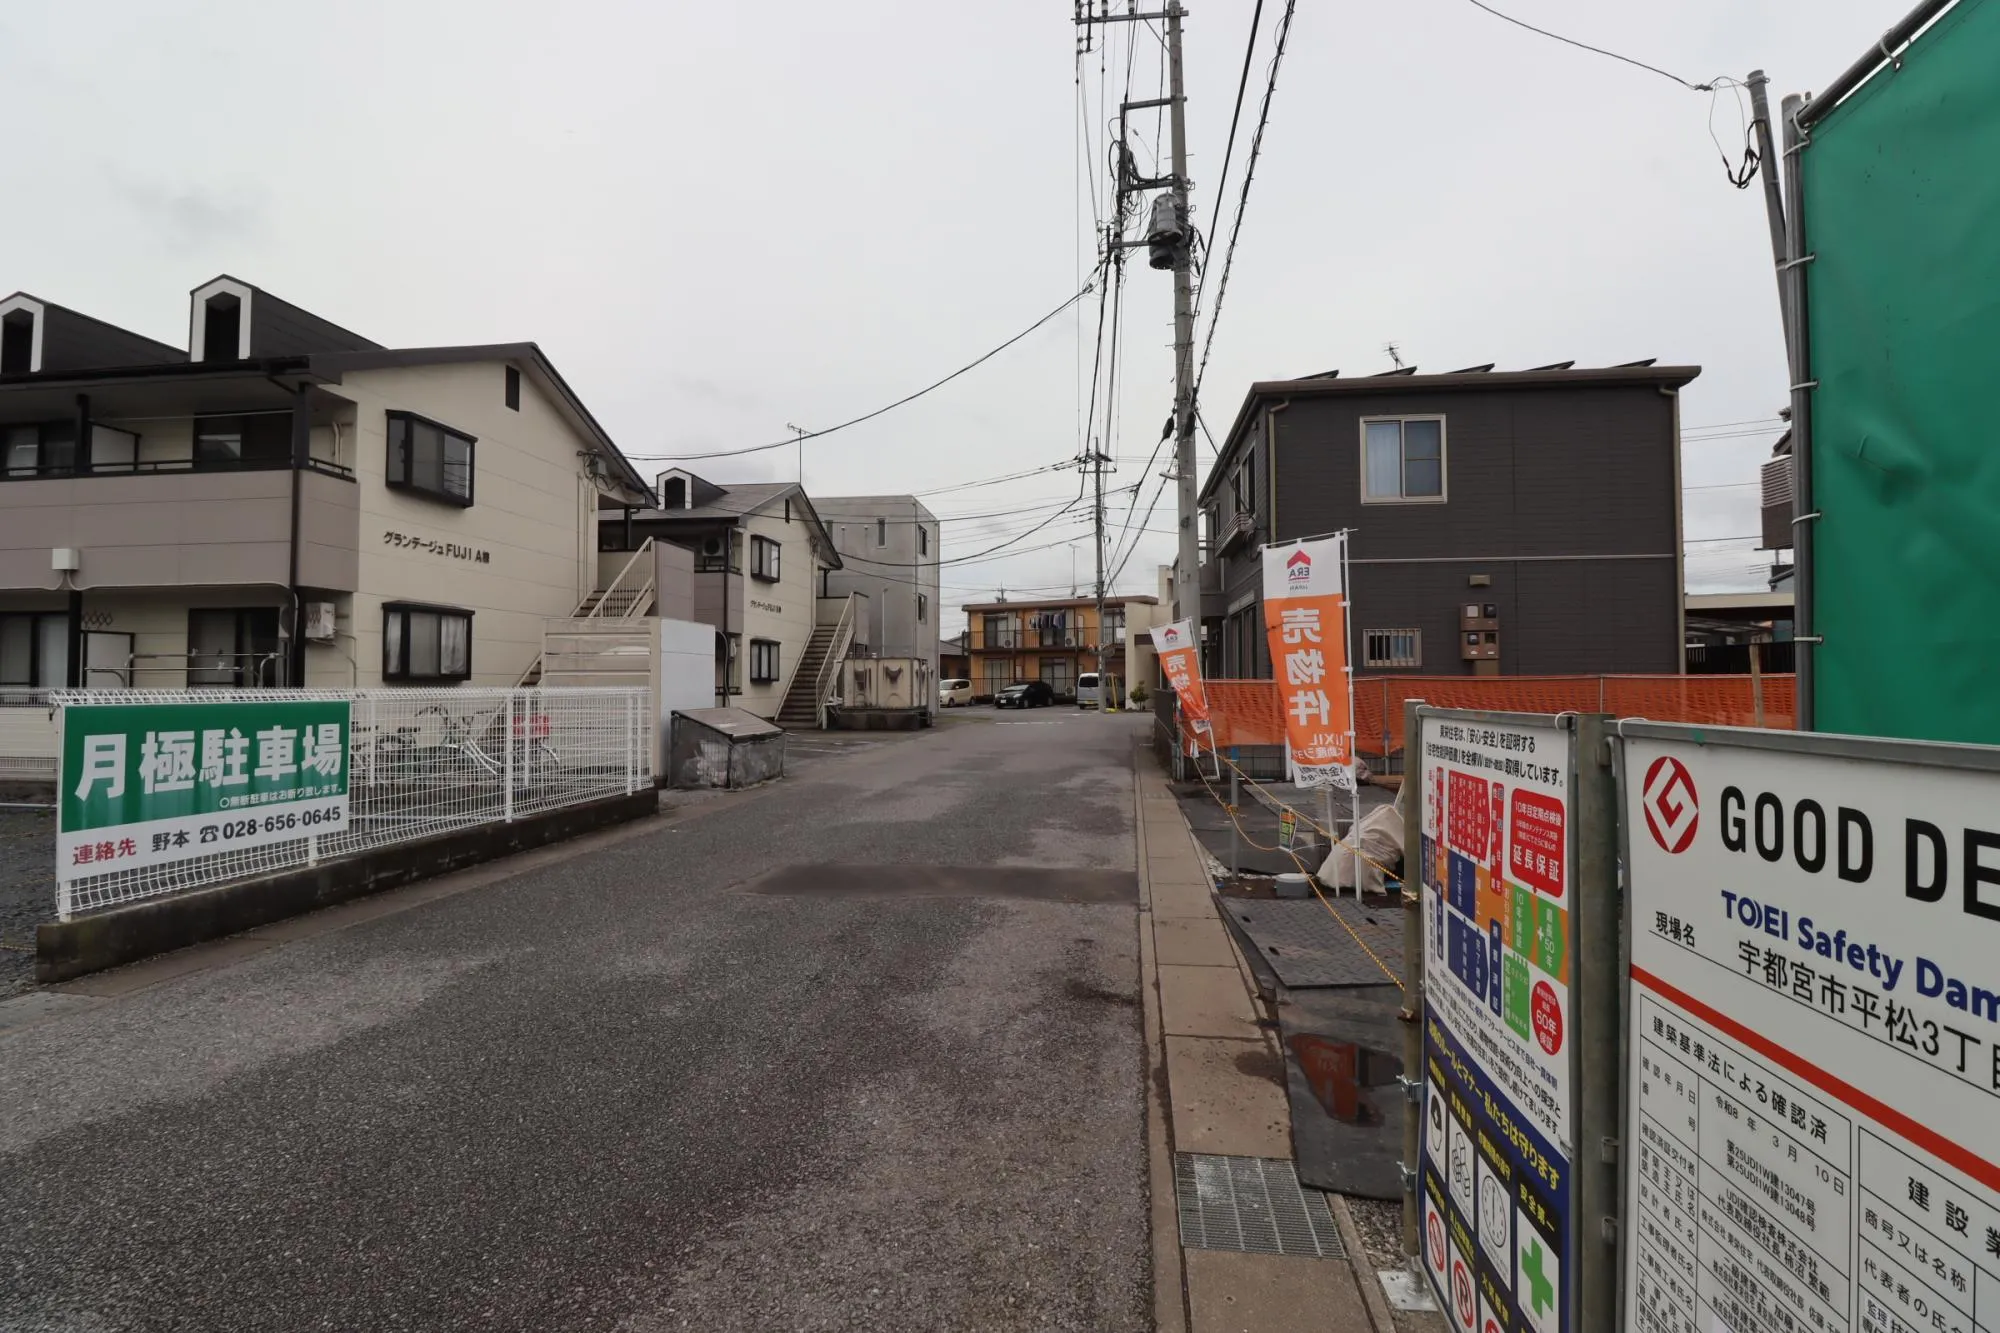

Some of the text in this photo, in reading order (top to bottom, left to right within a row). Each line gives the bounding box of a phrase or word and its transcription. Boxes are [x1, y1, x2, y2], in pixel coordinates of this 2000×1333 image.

[75, 724, 342, 801] 月極駐車場
[72, 806, 341, 866] 連絡先 野本 028-656-0645
[1513, 844, 1559, 882] 延長保証
[1720, 785, 2000, 922] GOOD DE
[1655, 911, 1695, 947] 現場名
[1798, 917, 1903, 991] Safety
[1536, 1009, 1557, 1036] 60年
[1653, 1016, 1828, 1144] 建築基準法による確認済
[1484, 1092, 1560, 1191] 私たちは守ります
[1772, 1135, 1779, 1148] 3
[1788, 1144, 1797, 1162] 月
[1815, 1164, 1829, 1183] 10
[1834, 1177, 1844, 1196] 日
[1520, 1184, 1554, 1232] 安全第一
[1865, 1207, 1967, 1293] 商号又は名称
